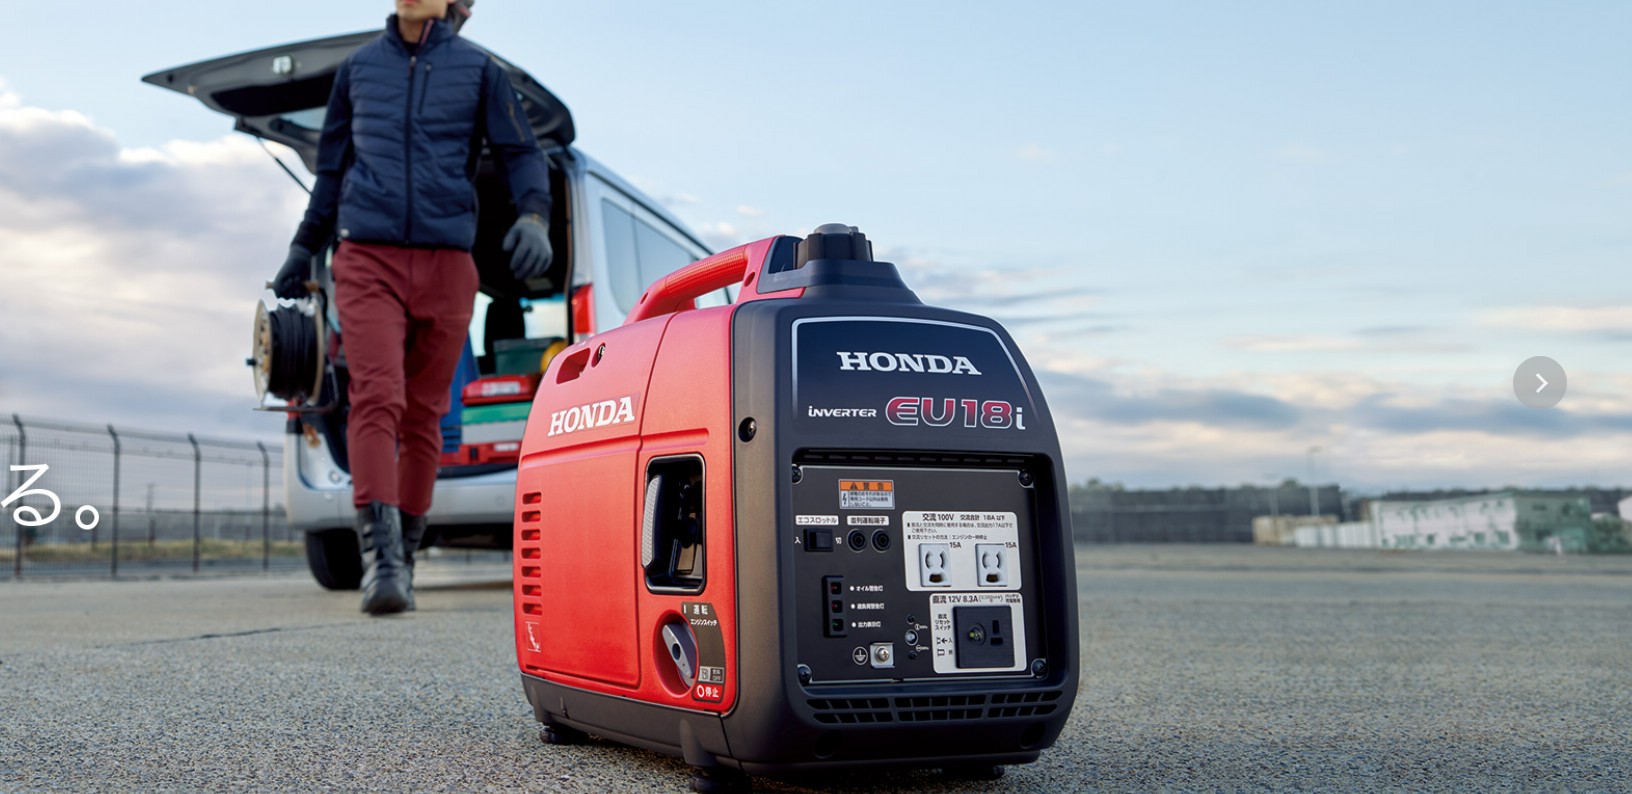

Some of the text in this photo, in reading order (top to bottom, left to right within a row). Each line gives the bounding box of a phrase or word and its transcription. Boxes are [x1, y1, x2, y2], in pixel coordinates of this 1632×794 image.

[837, 351, 982, 375] HONDA
[547, 396, 635, 437] HONDA
[797, 516, 837, 524] エコスロットル
[949, 541, 962, 549] 15A
[1005, 541, 1018, 549] 15A
[948, 594, 961, 603] 12V
[962, 594, 979, 603] 8.3A
